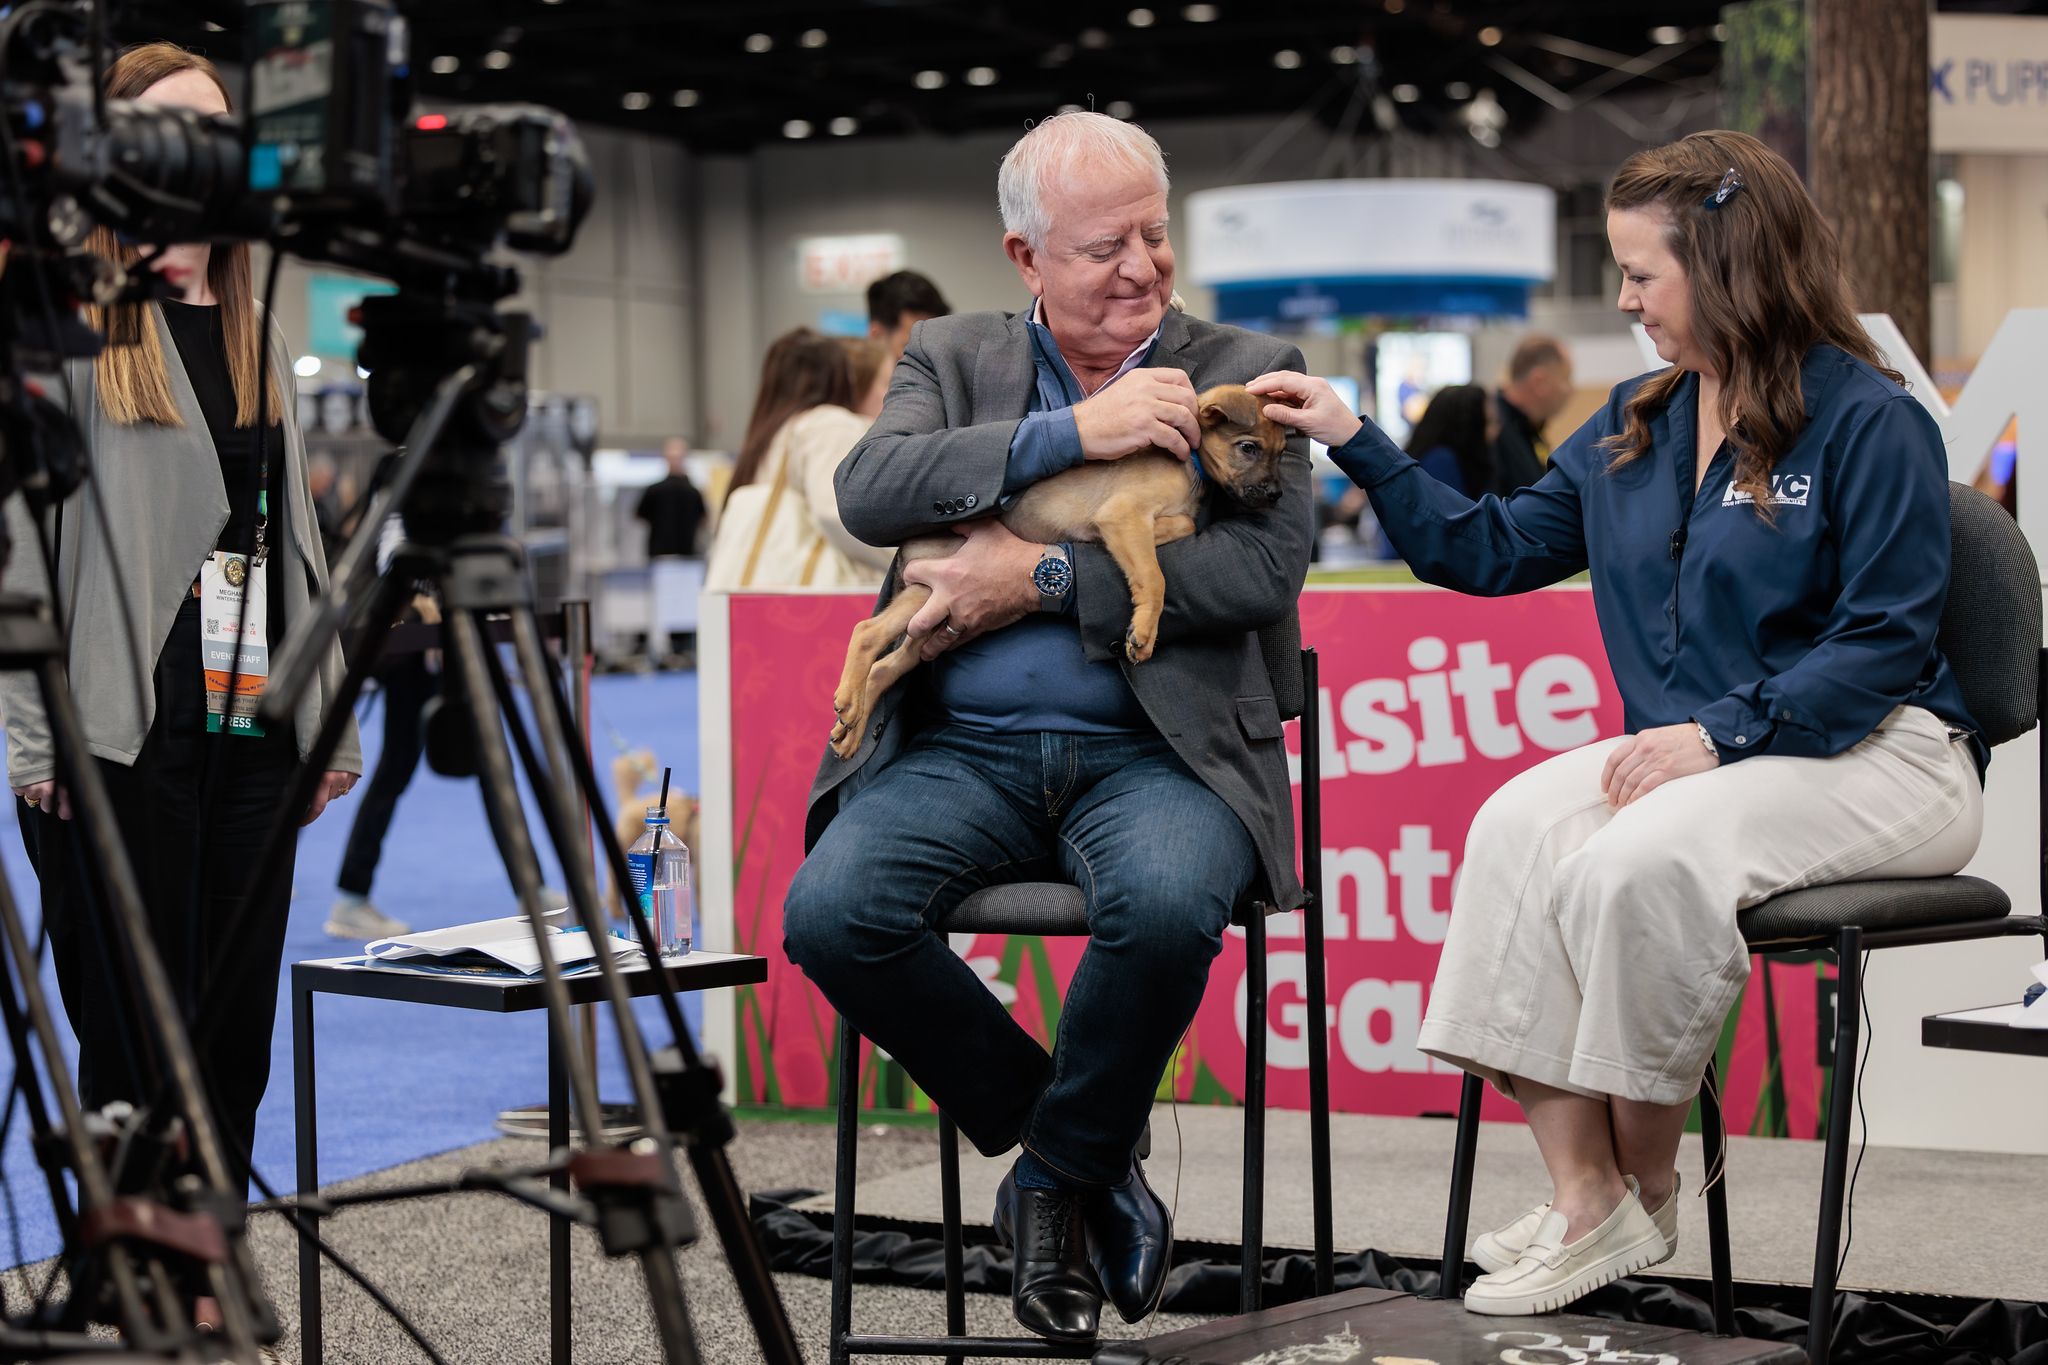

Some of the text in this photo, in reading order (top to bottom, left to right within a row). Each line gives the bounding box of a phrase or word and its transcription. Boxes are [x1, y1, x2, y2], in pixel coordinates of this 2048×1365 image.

[1722, 474, 1811, 502] NVC
[219, 589, 244, 597] MEGHAN
[211, 651, 260, 664] EVENT STAFF
[220, 715, 251, 728] PRESS
